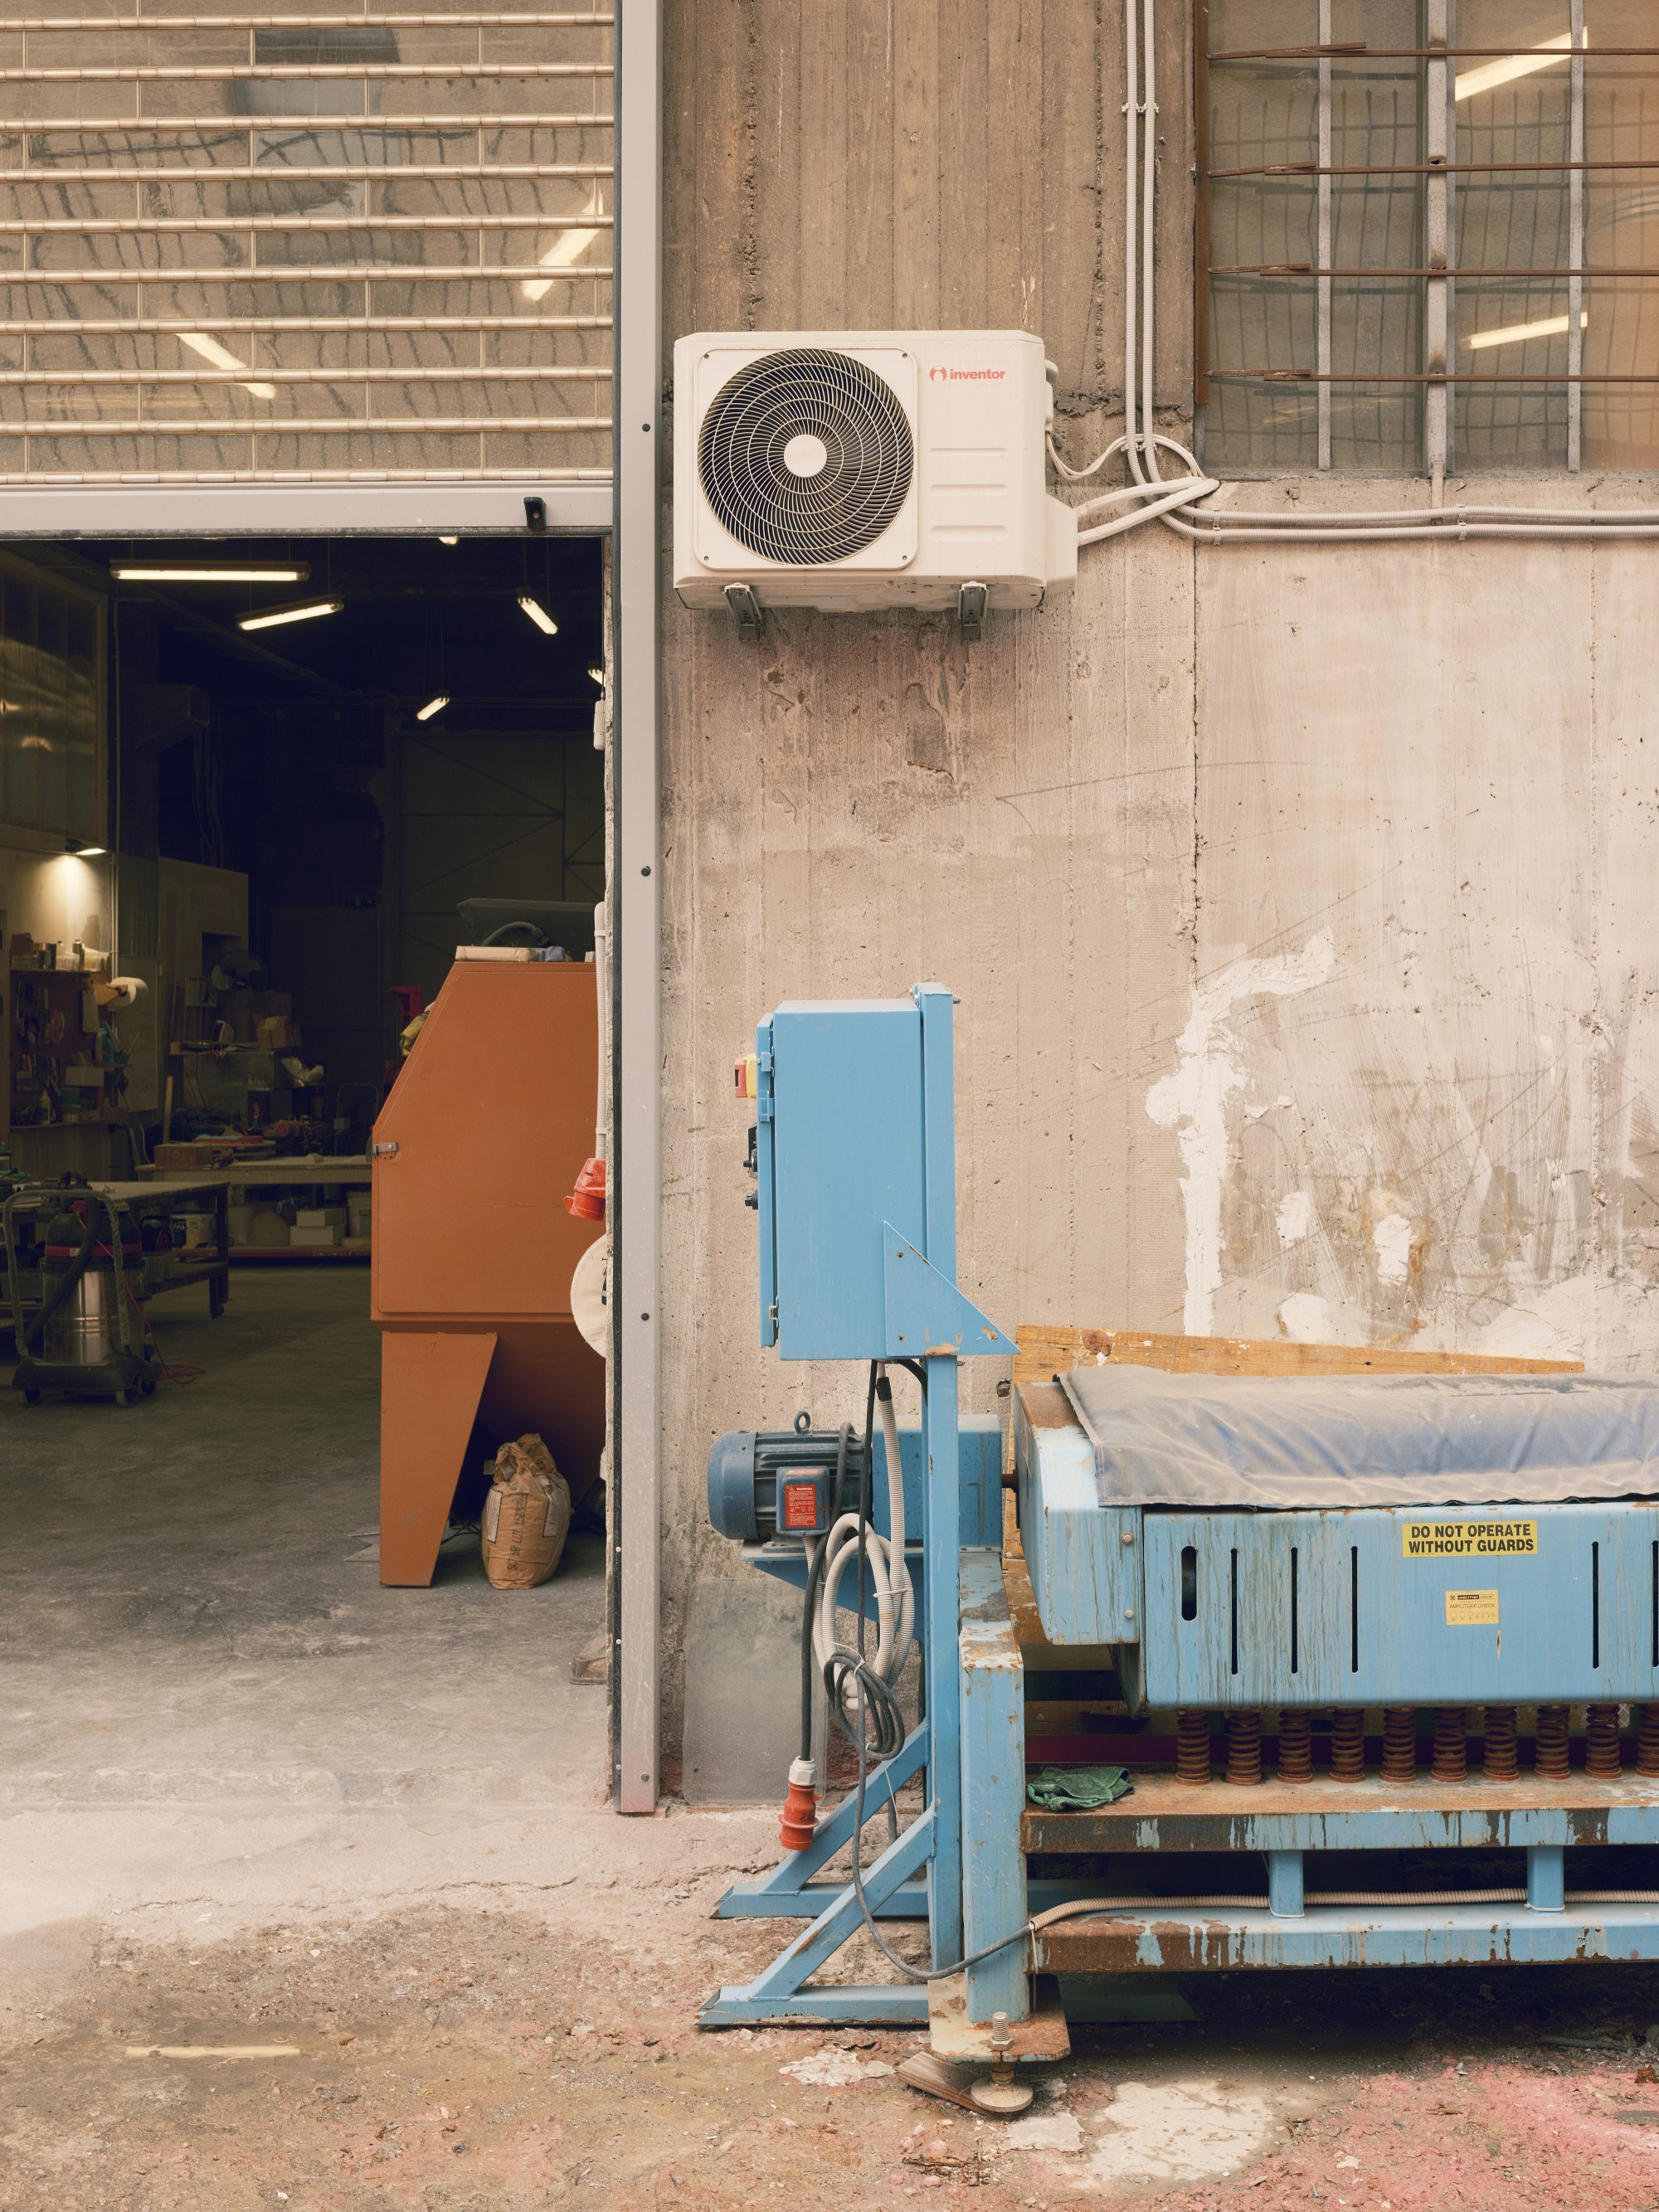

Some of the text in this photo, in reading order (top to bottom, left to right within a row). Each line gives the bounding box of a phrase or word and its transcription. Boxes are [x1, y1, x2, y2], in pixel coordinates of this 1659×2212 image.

[950, 369, 1005, 380] inventor
[1411, 1524, 1531, 1539] DO NOT OPERATE
[1408, 1539, 1534, 1553] WITHOUT GUARDS
